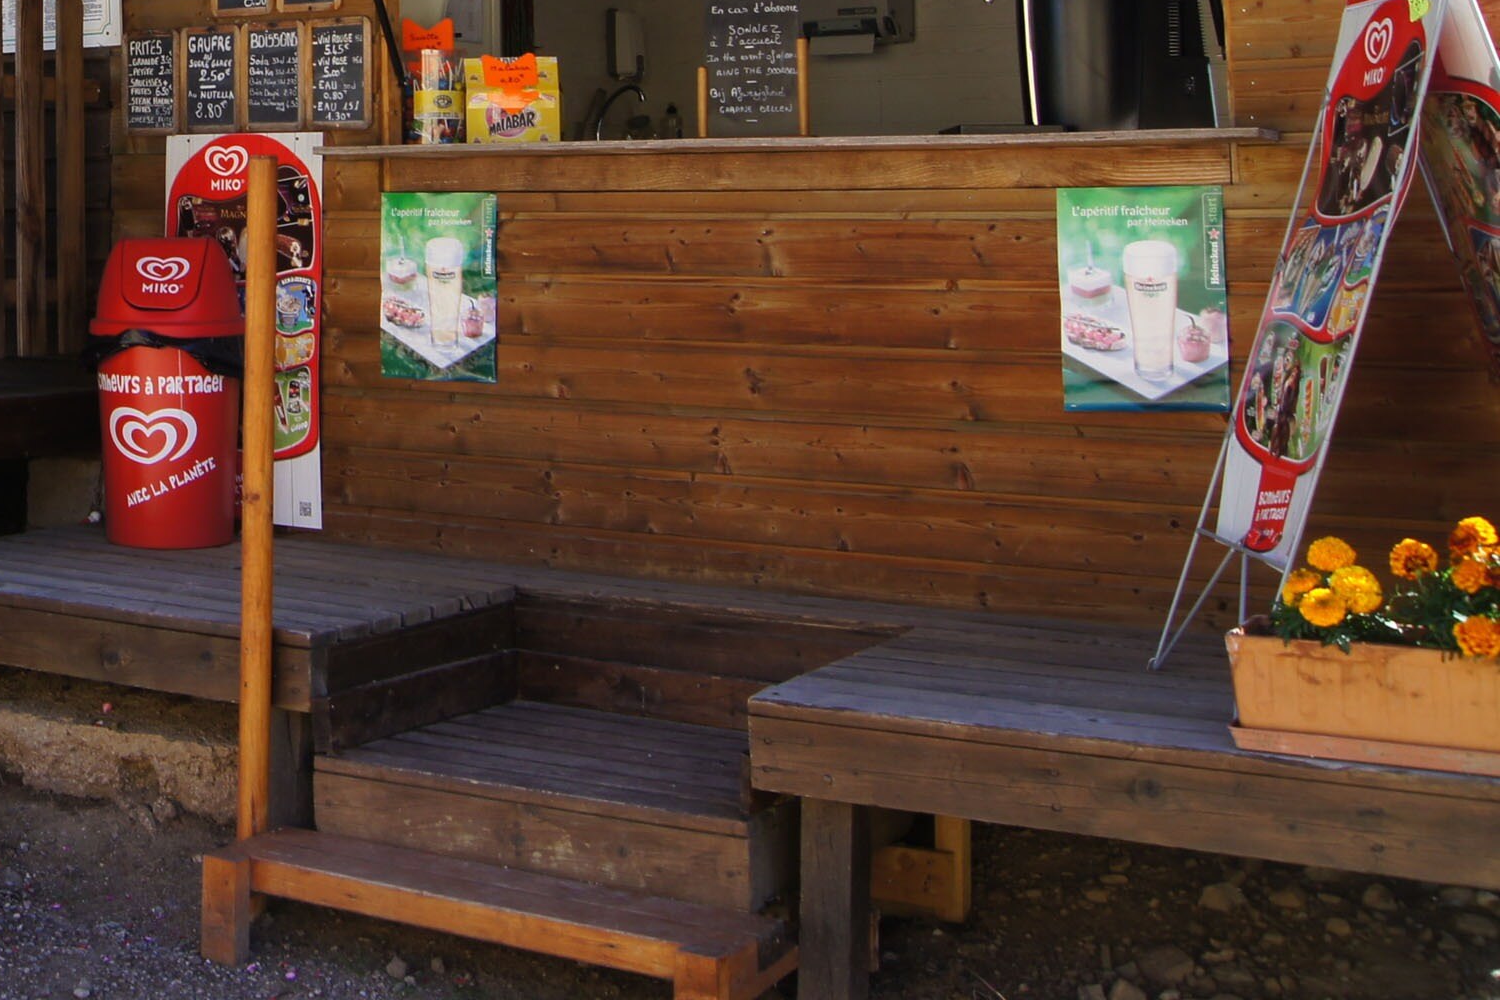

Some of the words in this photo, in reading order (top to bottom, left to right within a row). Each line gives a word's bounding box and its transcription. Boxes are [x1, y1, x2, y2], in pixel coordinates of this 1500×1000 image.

[711, 5, 724, 15] En
[727, 6, 749, 14] cas
[728, 24, 782, 36] SONNEZ
[129, 39, 163, 56] FRITES
[188, 35, 232, 53] GAUFRE
[709, 36, 718, 47] à
[723, 52, 737, 62] the
[716, 68, 740, 77] RING
[743, 66, 762, 75] THE
[1362, 67, 1385, 87] MIKO
[318, 80, 338, 90] EAU
[200, 90, 235, 99] NUTELLA
[317, 101, 337, 112] EAU
[489, 111, 536, 136] MALABAR
[211, 179, 242, 191] MIKO
[1071, 205, 1119, 218] L'apéritif
[1120, 205, 1171, 217] fraîcheur
[1126, 218, 1145, 228] par
[1145, 216, 1188, 227] Heineken
[1209, 240, 1221, 286] Heineken
[142, 282, 180, 294] MIKO
[144, 377, 154, 396] à
[126, 486, 151, 508] AVEC
[150, 480, 169, 497] LA
[168, 456, 217, 489] PLANÈTE
